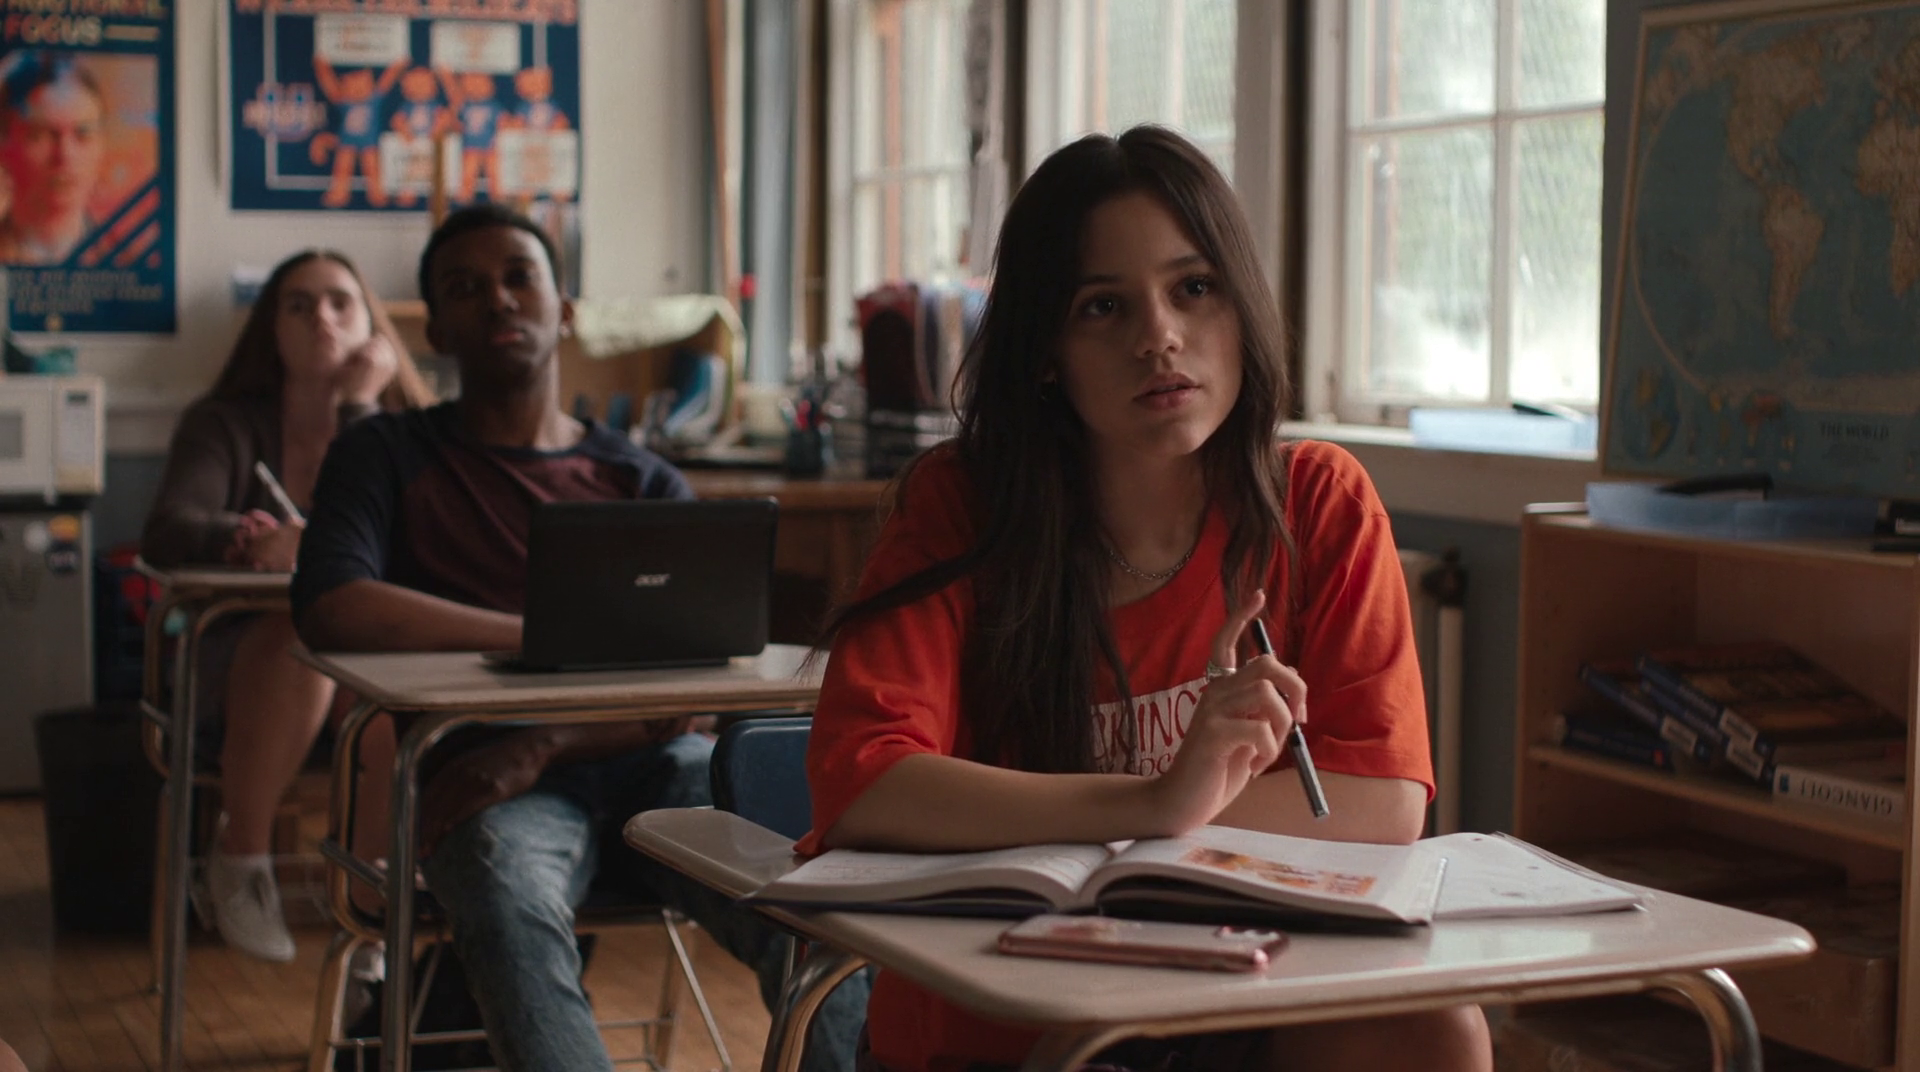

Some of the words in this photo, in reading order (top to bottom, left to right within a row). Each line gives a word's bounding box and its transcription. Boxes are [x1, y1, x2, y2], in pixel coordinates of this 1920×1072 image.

[5, 13, 102, 46] FOCUS
[1820, 421, 1842, 437] THE
[1845, 423, 1889, 441] WORLD
[1799, 777, 1893, 816] GIANCOLI
